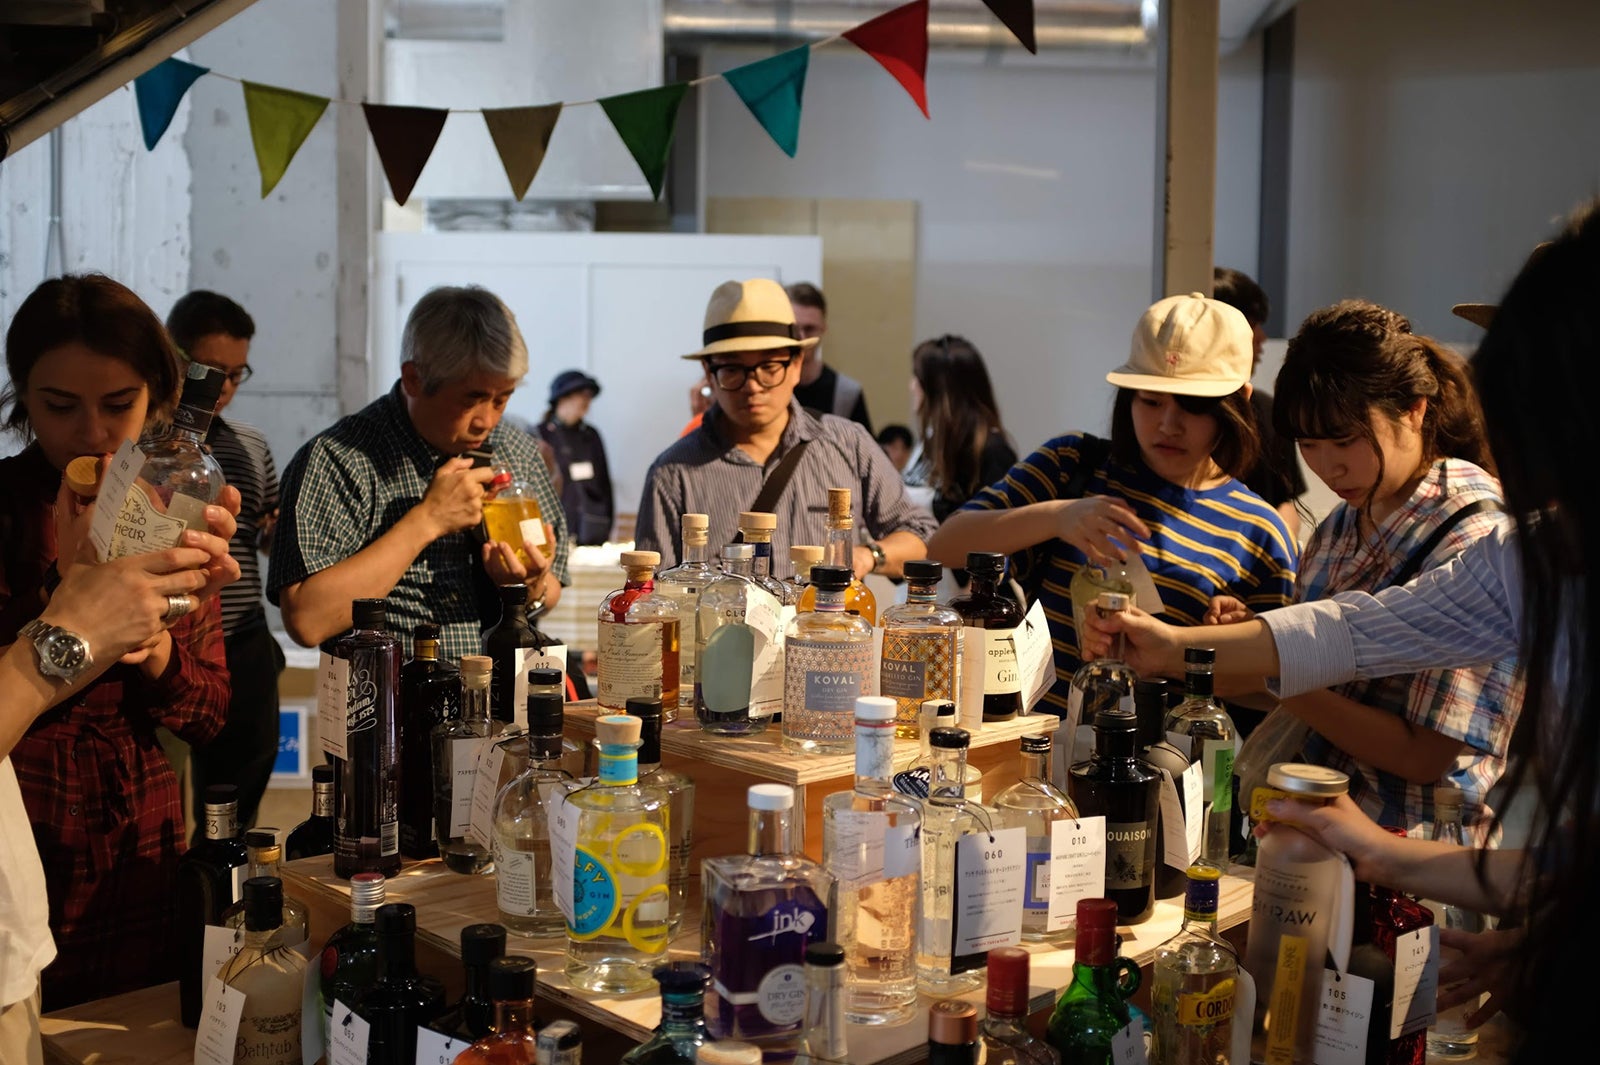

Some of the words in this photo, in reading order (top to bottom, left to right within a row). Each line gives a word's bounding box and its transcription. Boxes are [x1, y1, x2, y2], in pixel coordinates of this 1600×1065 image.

[535, 662, 550, 670] 012
[882, 662, 916, 673] KOVAL
[814, 675, 855, 685] KOVAL
[1072, 836, 1087, 846] 010
[984, 850, 1003, 860] 060
[589, 891, 610, 900] GIN
[767, 993, 787, 1002] DRY
[1328, 988, 1347, 1000] 105
[236, 1036, 293, 1060] Bathtub
